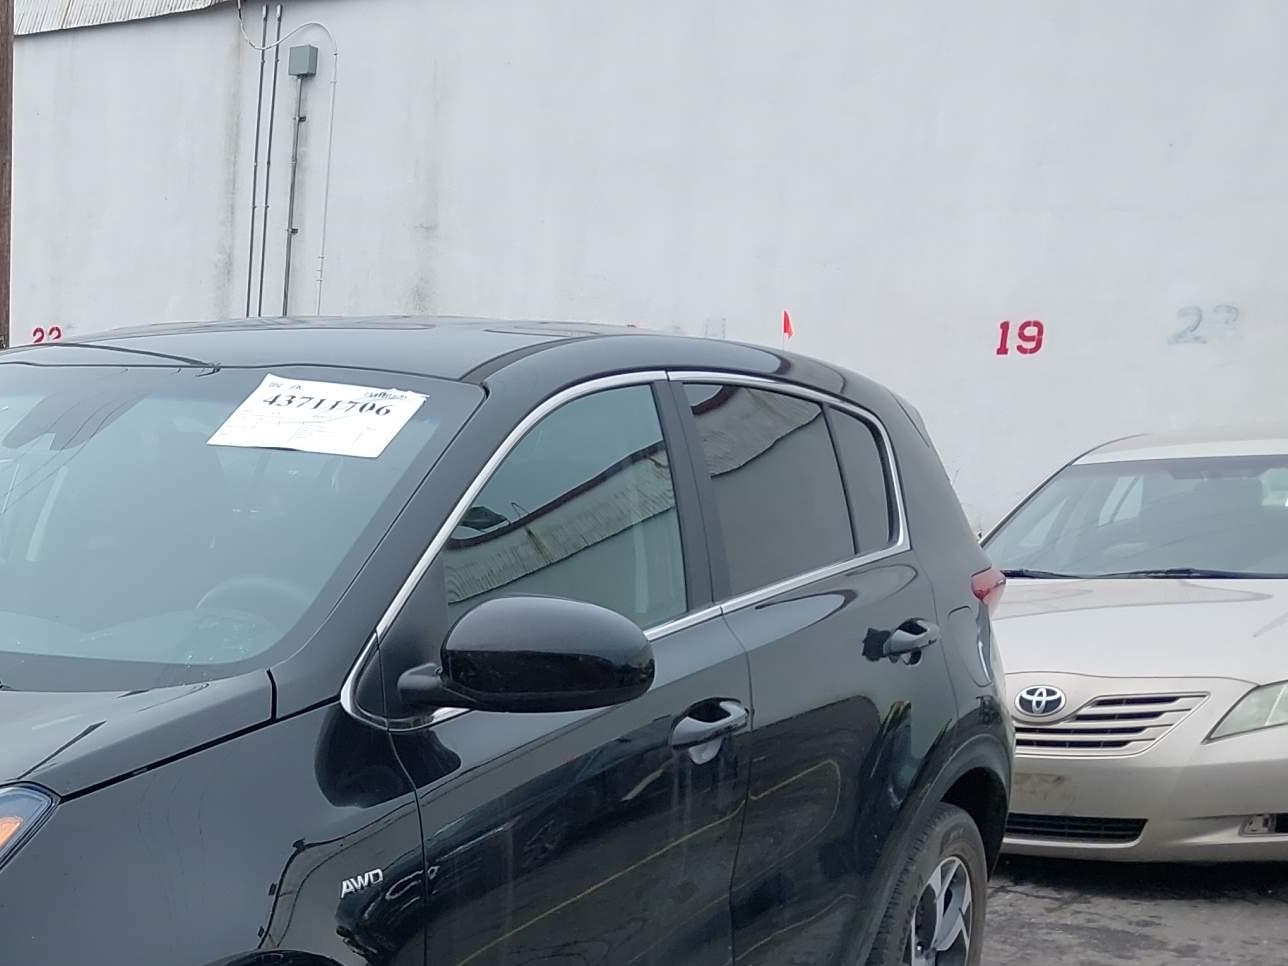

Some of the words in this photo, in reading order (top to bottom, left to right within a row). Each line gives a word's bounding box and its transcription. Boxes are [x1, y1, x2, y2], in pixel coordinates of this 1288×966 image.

[996, 320, 1044, 355] 19
[263, 393, 392, 416] 43711706
[341, 868, 383, 899] AWD
